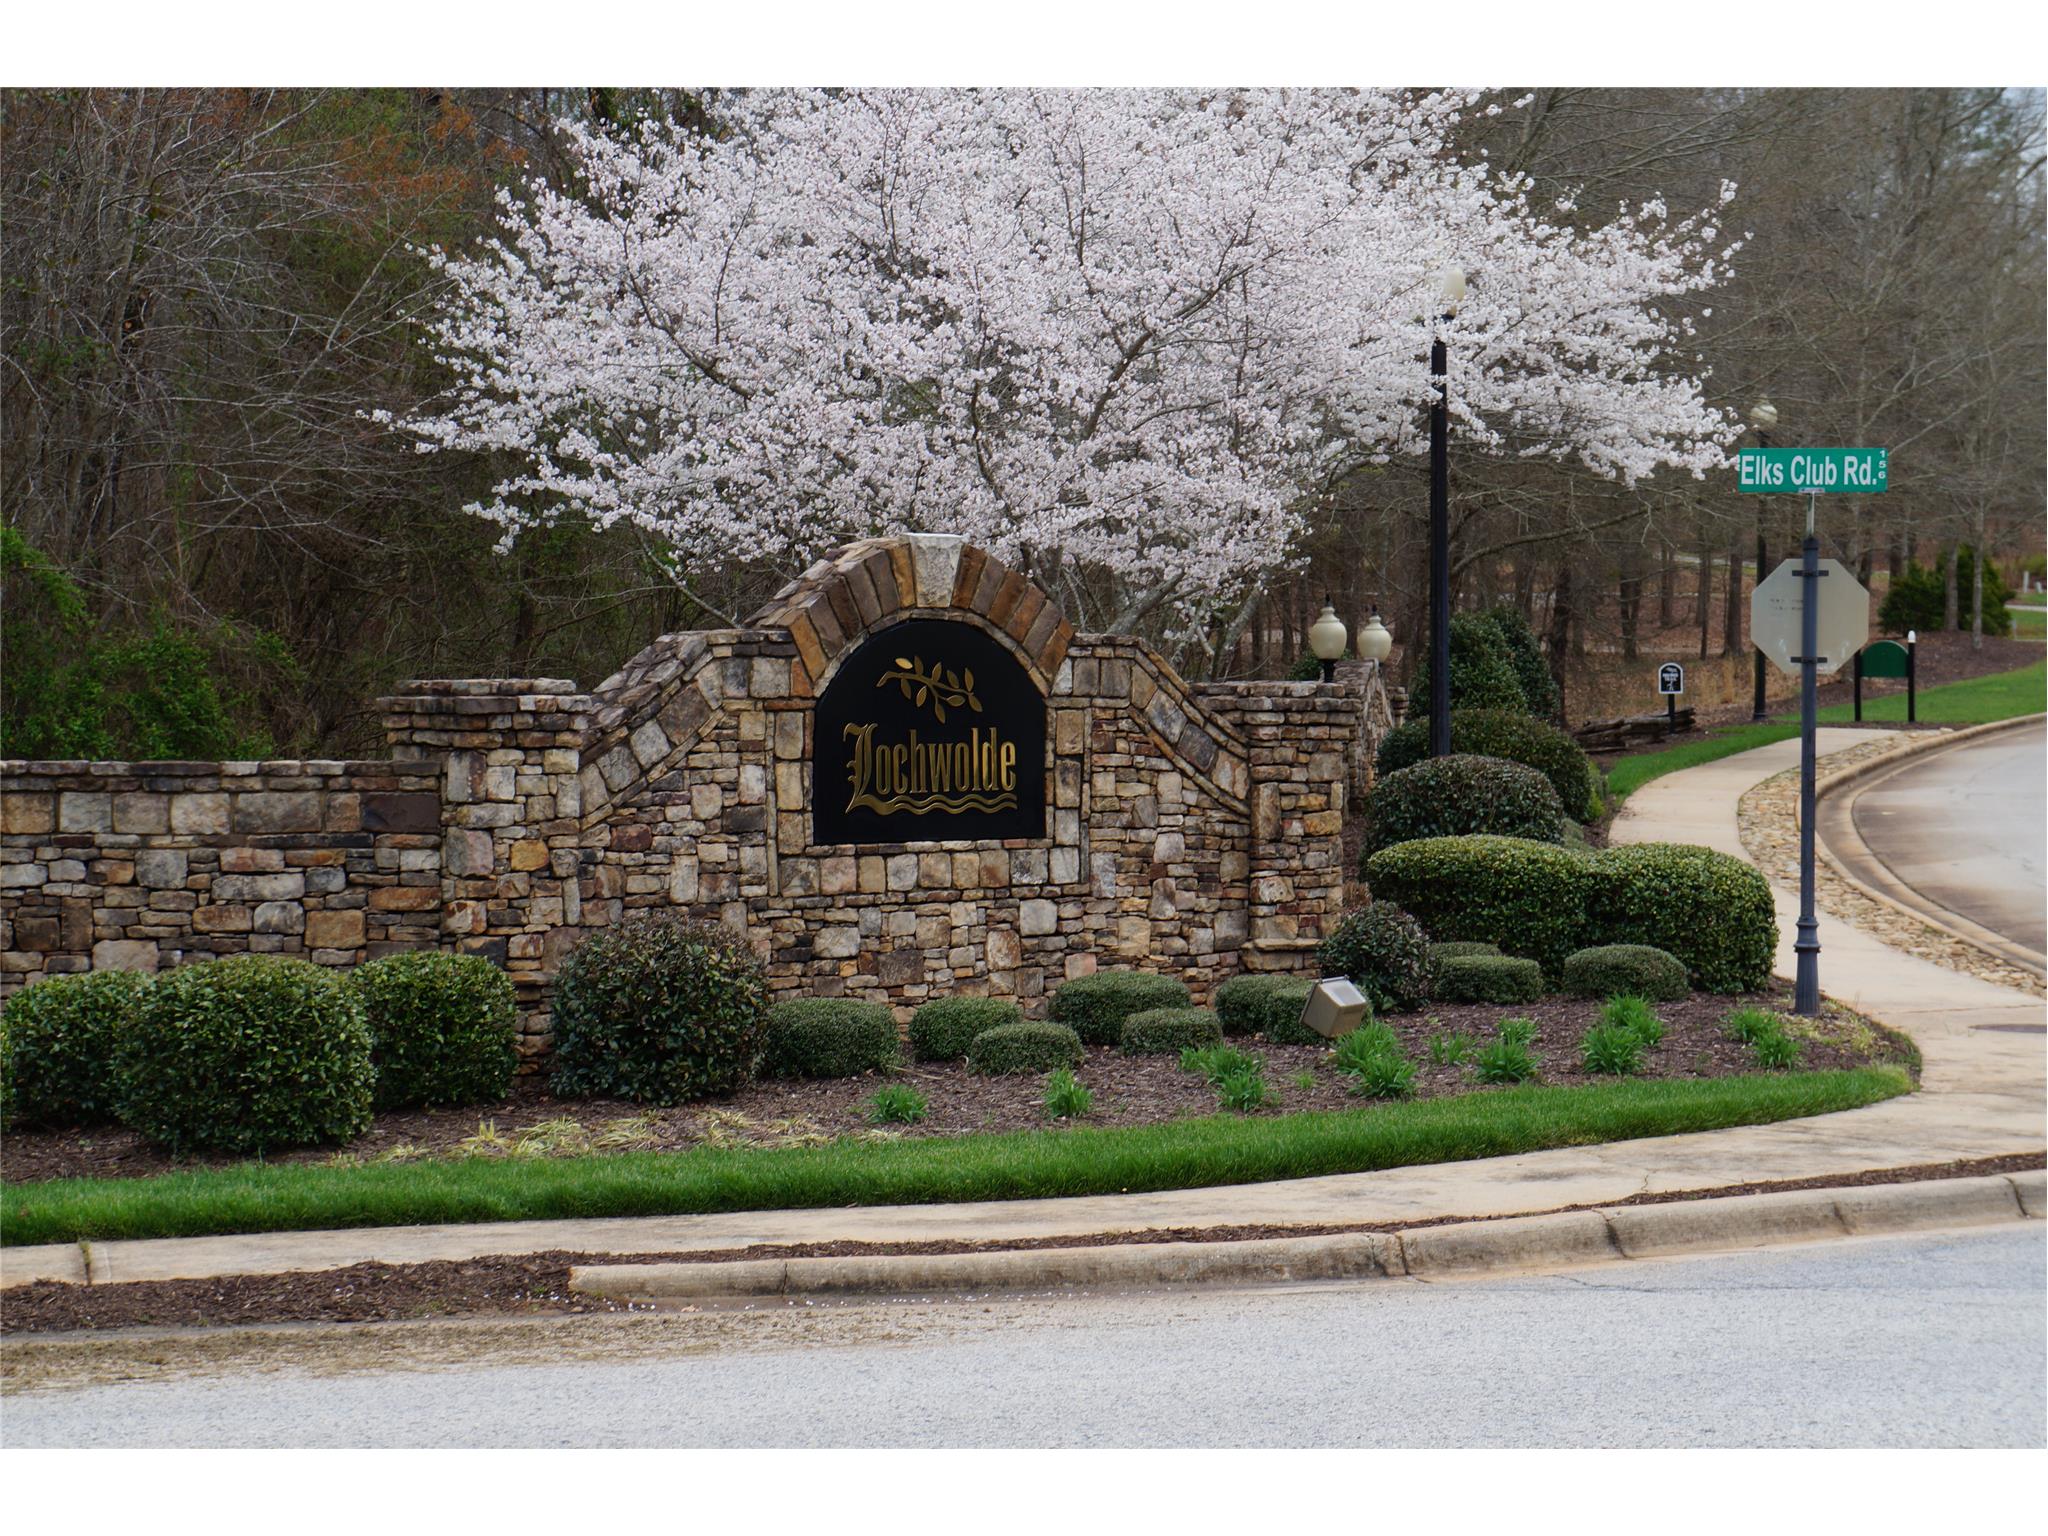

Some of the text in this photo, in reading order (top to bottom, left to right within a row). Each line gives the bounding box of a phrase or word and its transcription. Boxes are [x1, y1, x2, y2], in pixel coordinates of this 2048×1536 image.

[1741, 455, 1877, 485] Elks Club Rd.
[843, 722, 1017, 814] Lochwolde
